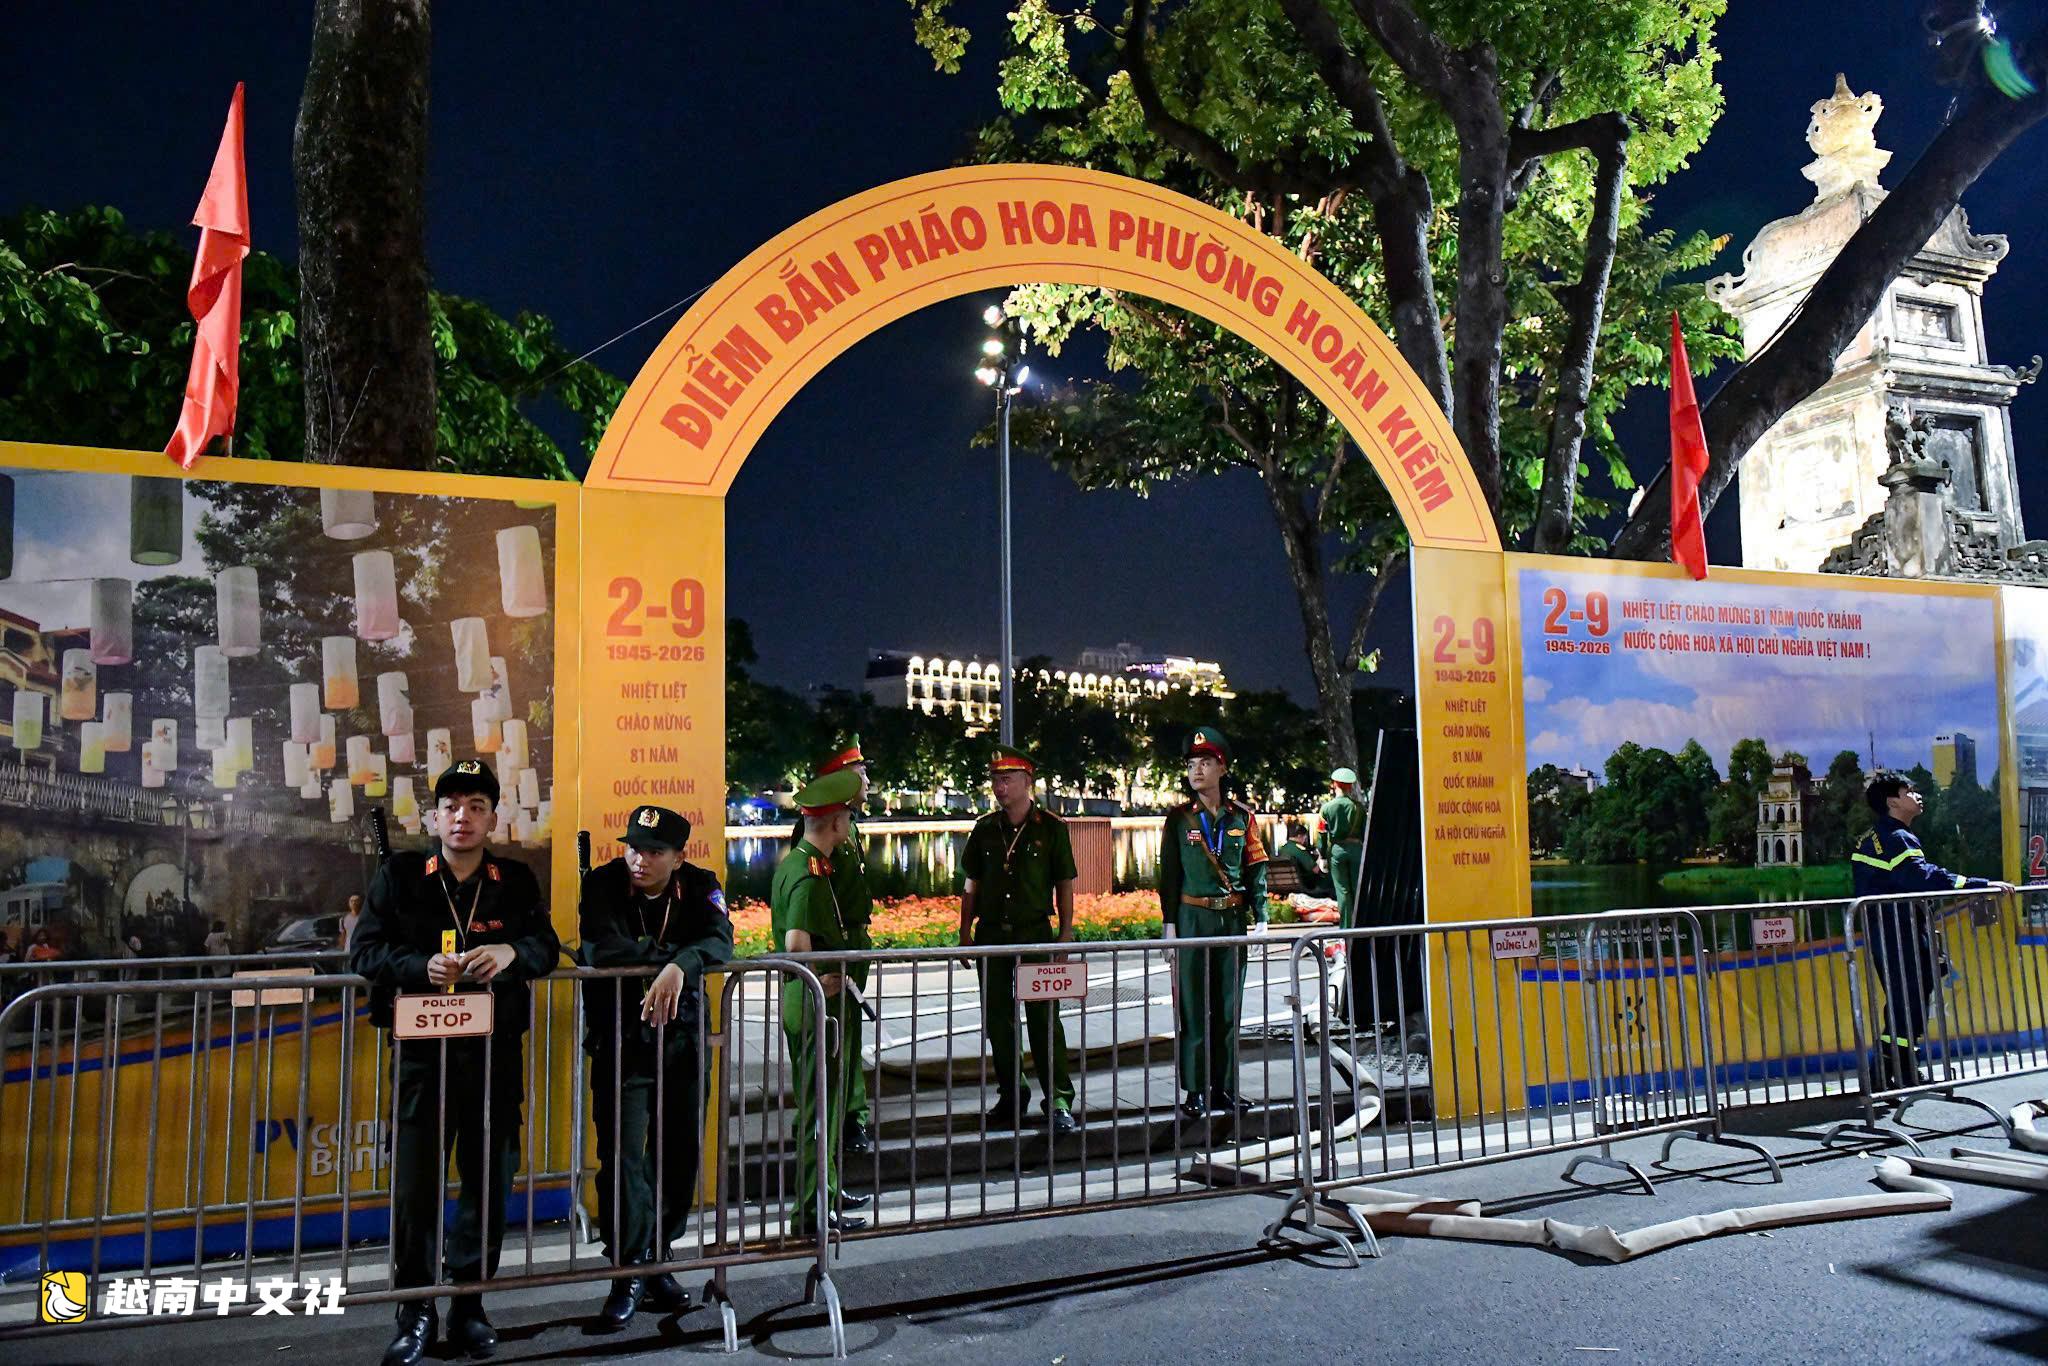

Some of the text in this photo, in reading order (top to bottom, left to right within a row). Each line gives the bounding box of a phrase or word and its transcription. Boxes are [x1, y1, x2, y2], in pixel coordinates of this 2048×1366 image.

[660, 201, 1454, 513] ĐIỂM BẮN PHÁO HOA PHƯỜNG HOÀN KIẾM
[606, 576, 705, 639] 2-9
[1543, 587, 1610, 638] 2-9
[1622, 599, 1656, 624] NHIỆT
[1659, 600, 1682, 625] LIỆT
[1685, 601, 1715, 623] CHÀO
[1718, 603, 1751, 625] MỪNG
[1753, 608, 1766, 625] 81
[1797, 607, 1825, 629] QUỐC
[1827, 610, 1862, 630] KHÁNH
[1433, 615, 1495, 665] 2-9
[1544, 639, 1611, 655] 1945-2026
[1623, 629, 1656, 650] NƯỚC
[1659, 630, 1690, 655] CỘNG
[1693, 632, 1716, 653] HOÀ
[1719, 633, 1734, 653] XÃ
[1736, 634, 1755, 658] HỘI
[1758, 633, 1779, 655] CHỦ
[1781, 637, 1815, 657] NGHĨA
[1816, 638, 1838, 661] VIỆT
[606, 645, 705, 662] 1945-2026
[1434, 669, 1497, 684] 1945-2026
[621, 681, 687, 703] NHIỆT LIỆT
[1445, 698, 1487, 716] NHIỆT LIỆT
[616, 712, 692, 731] CHÀO MỪNG
[1442, 723, 1464, 738] CHÀO
[630, 745, 678, 763] 81 NĂM
[1452, 751, 1462, 763] 81
[613, 775, 695, 797] QUỐC KHÁNH
[1443, 773, 1494, 790] QUỐC KHÁNH
[1461, 799, 1483, 817] CỘNG
[680, 808, 704, 827] OÀ
[596, 842, 613, 862] XÃ
[1472, 852, 1490, 865] NAM
[1763, 929, 1786, 939] STOP
[1037, 967, 1067, 975] POLICE
[1032, 979, 1072, 992] STOP
[422, 998, 465, 1008] POLICE
[415, 1012, 473, 1029] STOP
